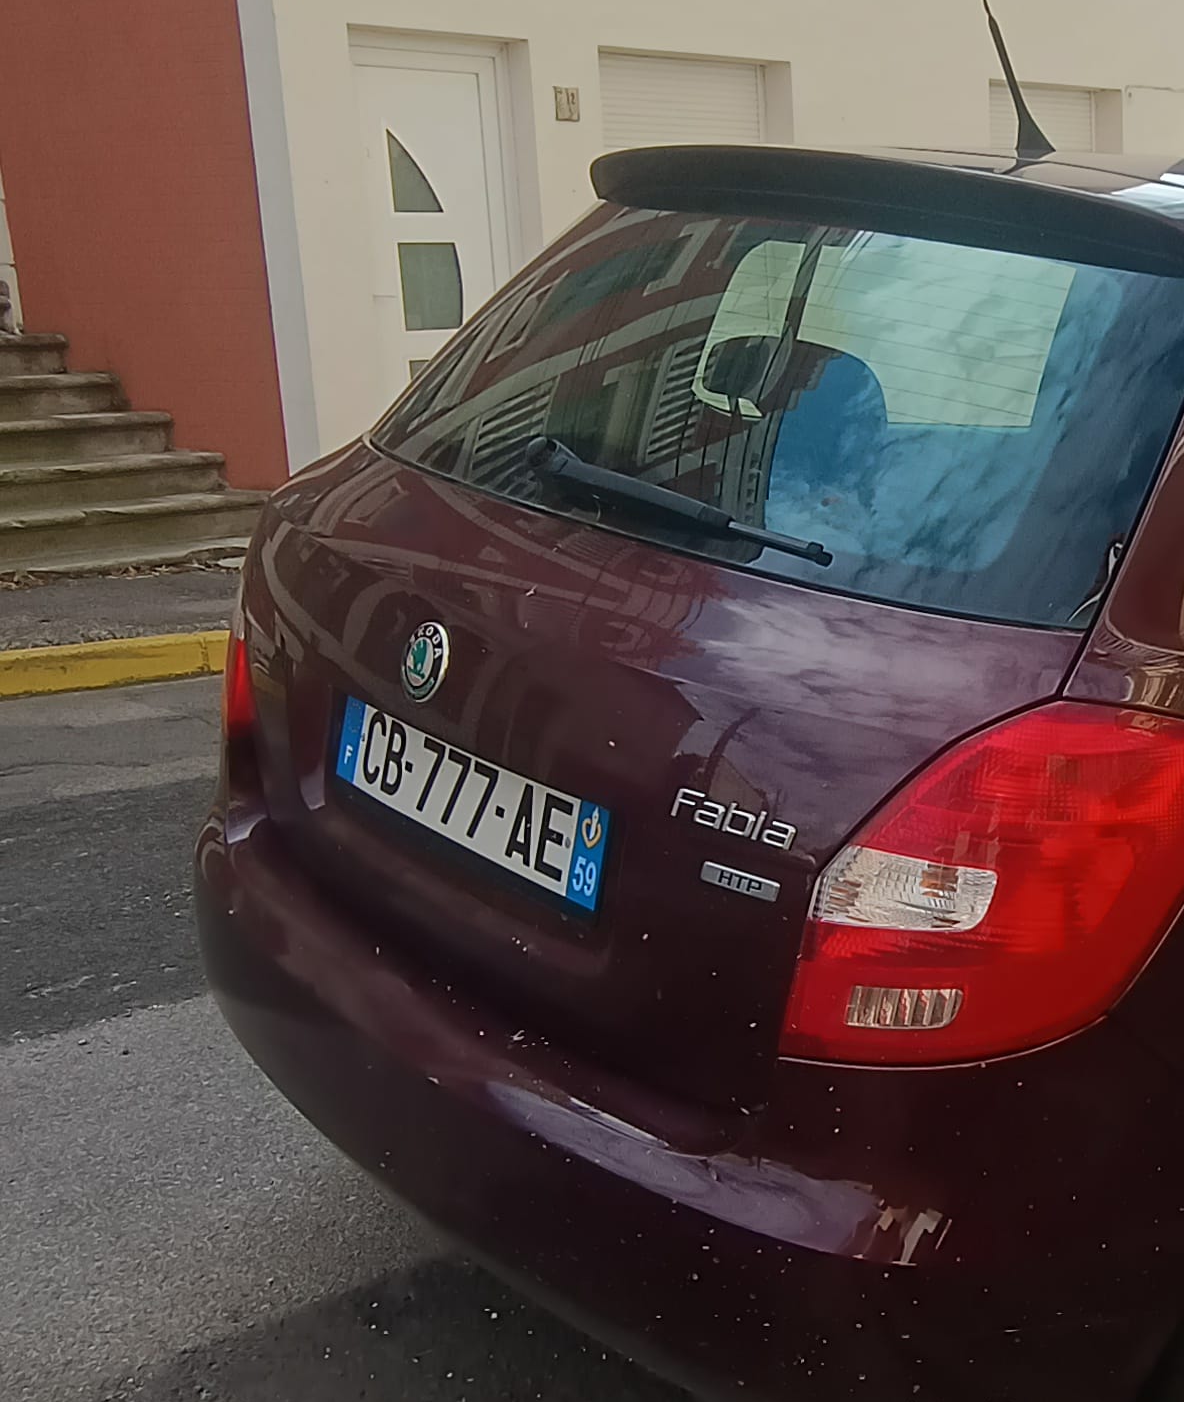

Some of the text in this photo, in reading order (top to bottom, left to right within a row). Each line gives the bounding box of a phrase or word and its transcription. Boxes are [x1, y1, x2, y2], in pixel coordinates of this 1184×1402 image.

[344, 745, 353, 764] F
[363, 711, 574, 882] CB-777-AE
[670, 788, 797, 850] Fabia
[572, 856, 597, 896] 59
[718, 870, 762, 892] HTP
